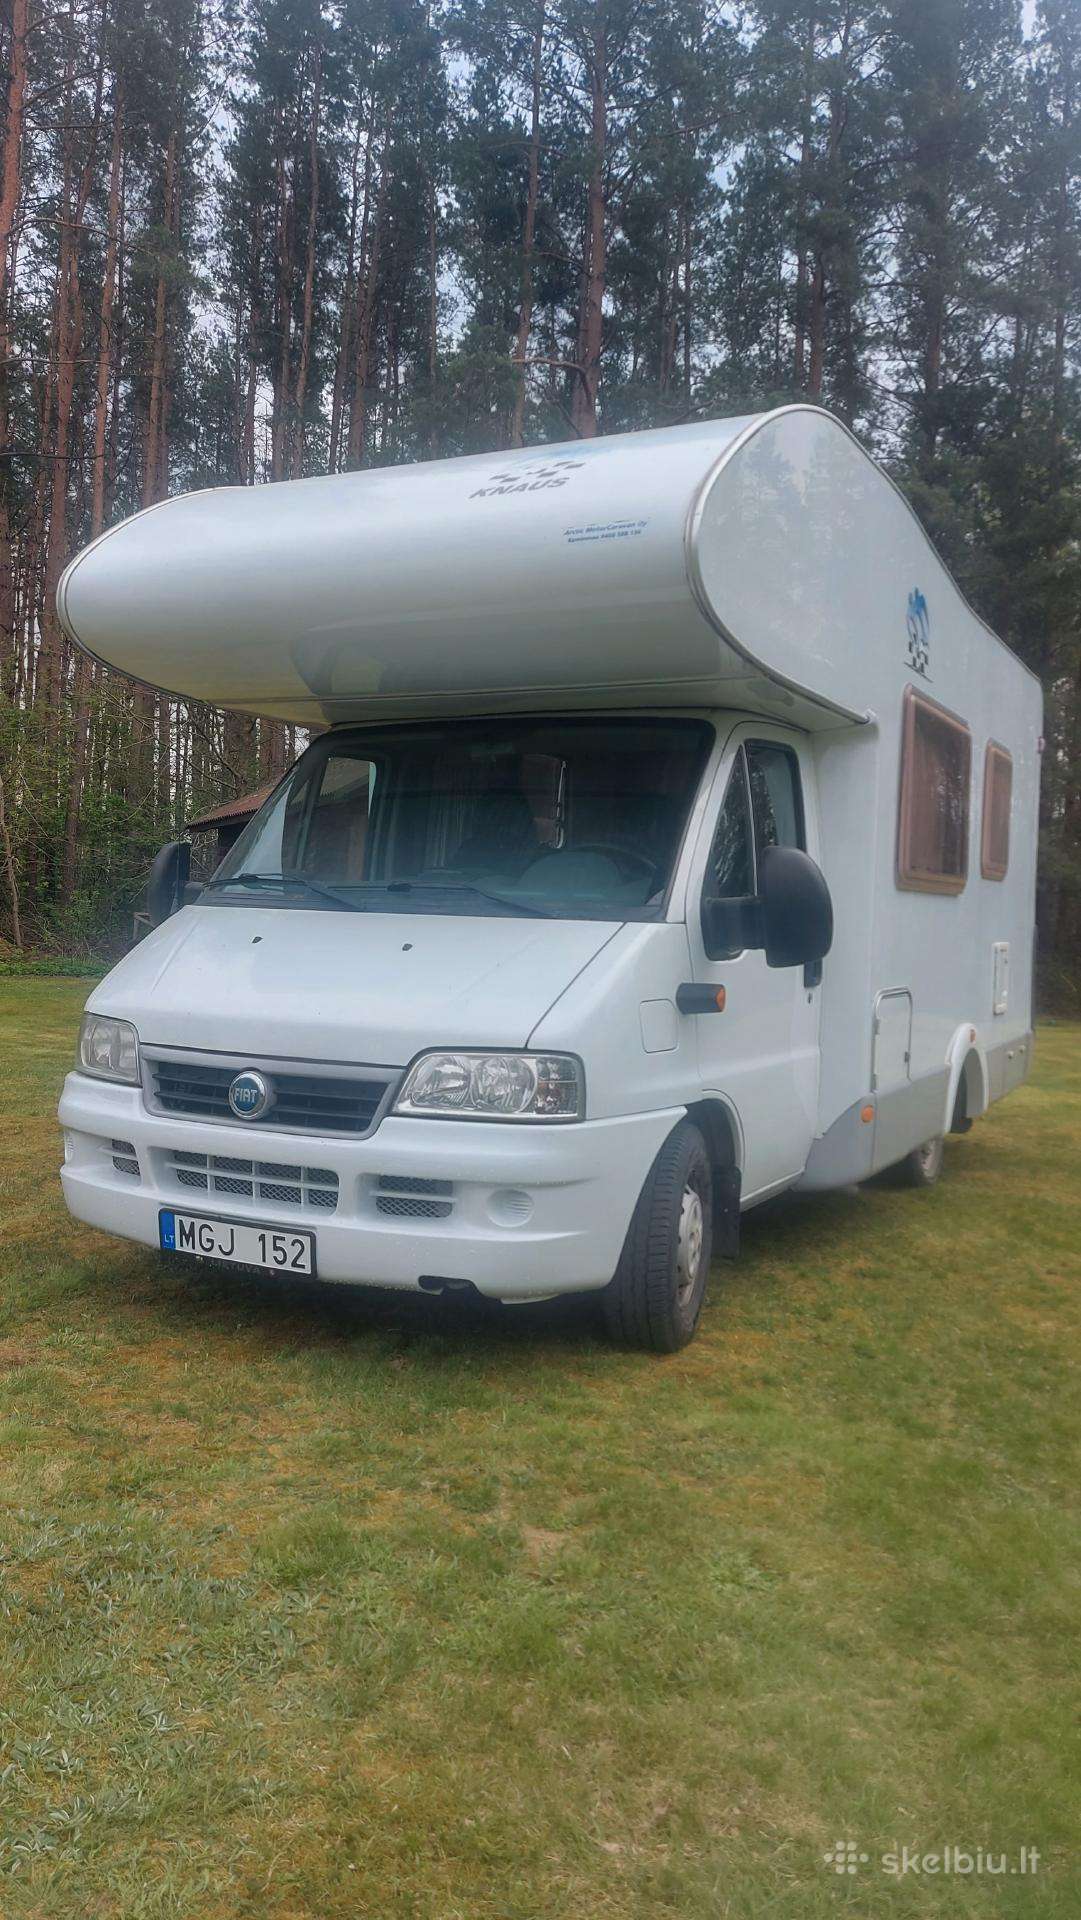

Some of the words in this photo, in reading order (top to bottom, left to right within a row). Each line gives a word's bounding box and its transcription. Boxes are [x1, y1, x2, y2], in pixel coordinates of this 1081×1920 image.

[468, 477, 570, 499] KNAUS
[234, 1087, 258, 1104] FIAT
[164, 1234, 174, 1245] LT
[178, 1219, 235, 1256] MGJ
[258, 1233, 306, 1269] 152
